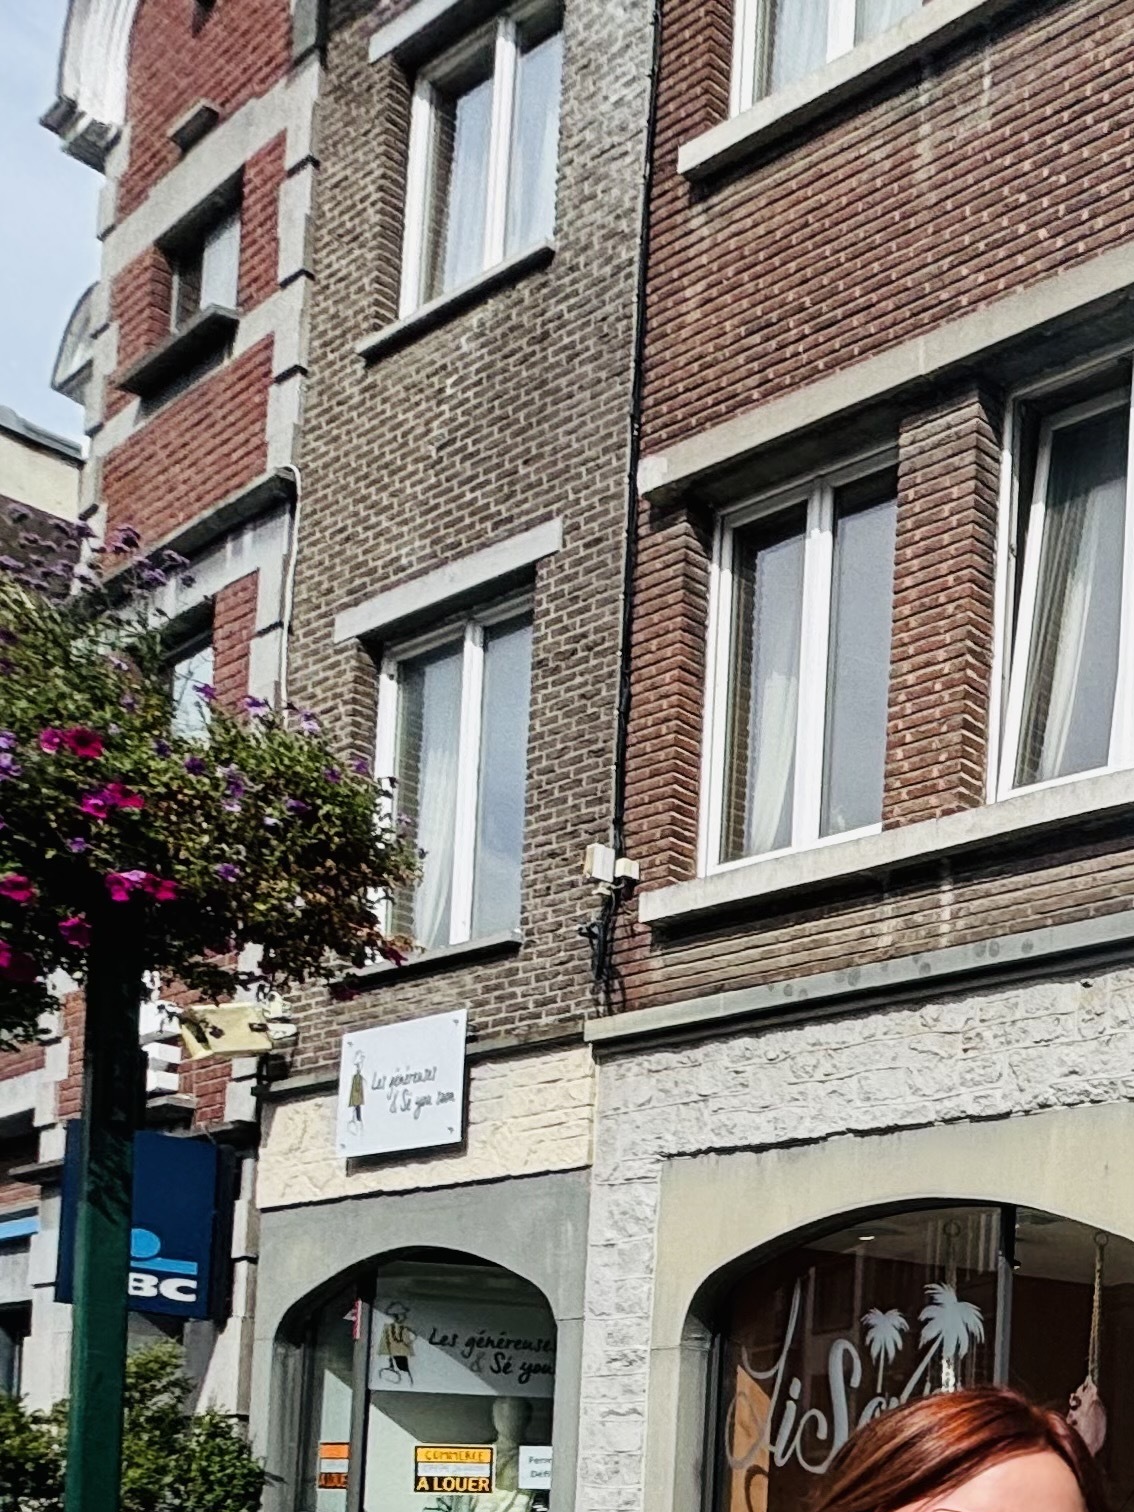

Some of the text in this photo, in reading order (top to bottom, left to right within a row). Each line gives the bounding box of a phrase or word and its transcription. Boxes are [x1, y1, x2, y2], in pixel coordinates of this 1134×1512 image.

[128, 1271, 198, 1303] BC
[428, 1328, 557, 1359] Les généreuse
[490, 1352, 514, 1375] Sé
[433, 1476, 490, 1492] LOUER
